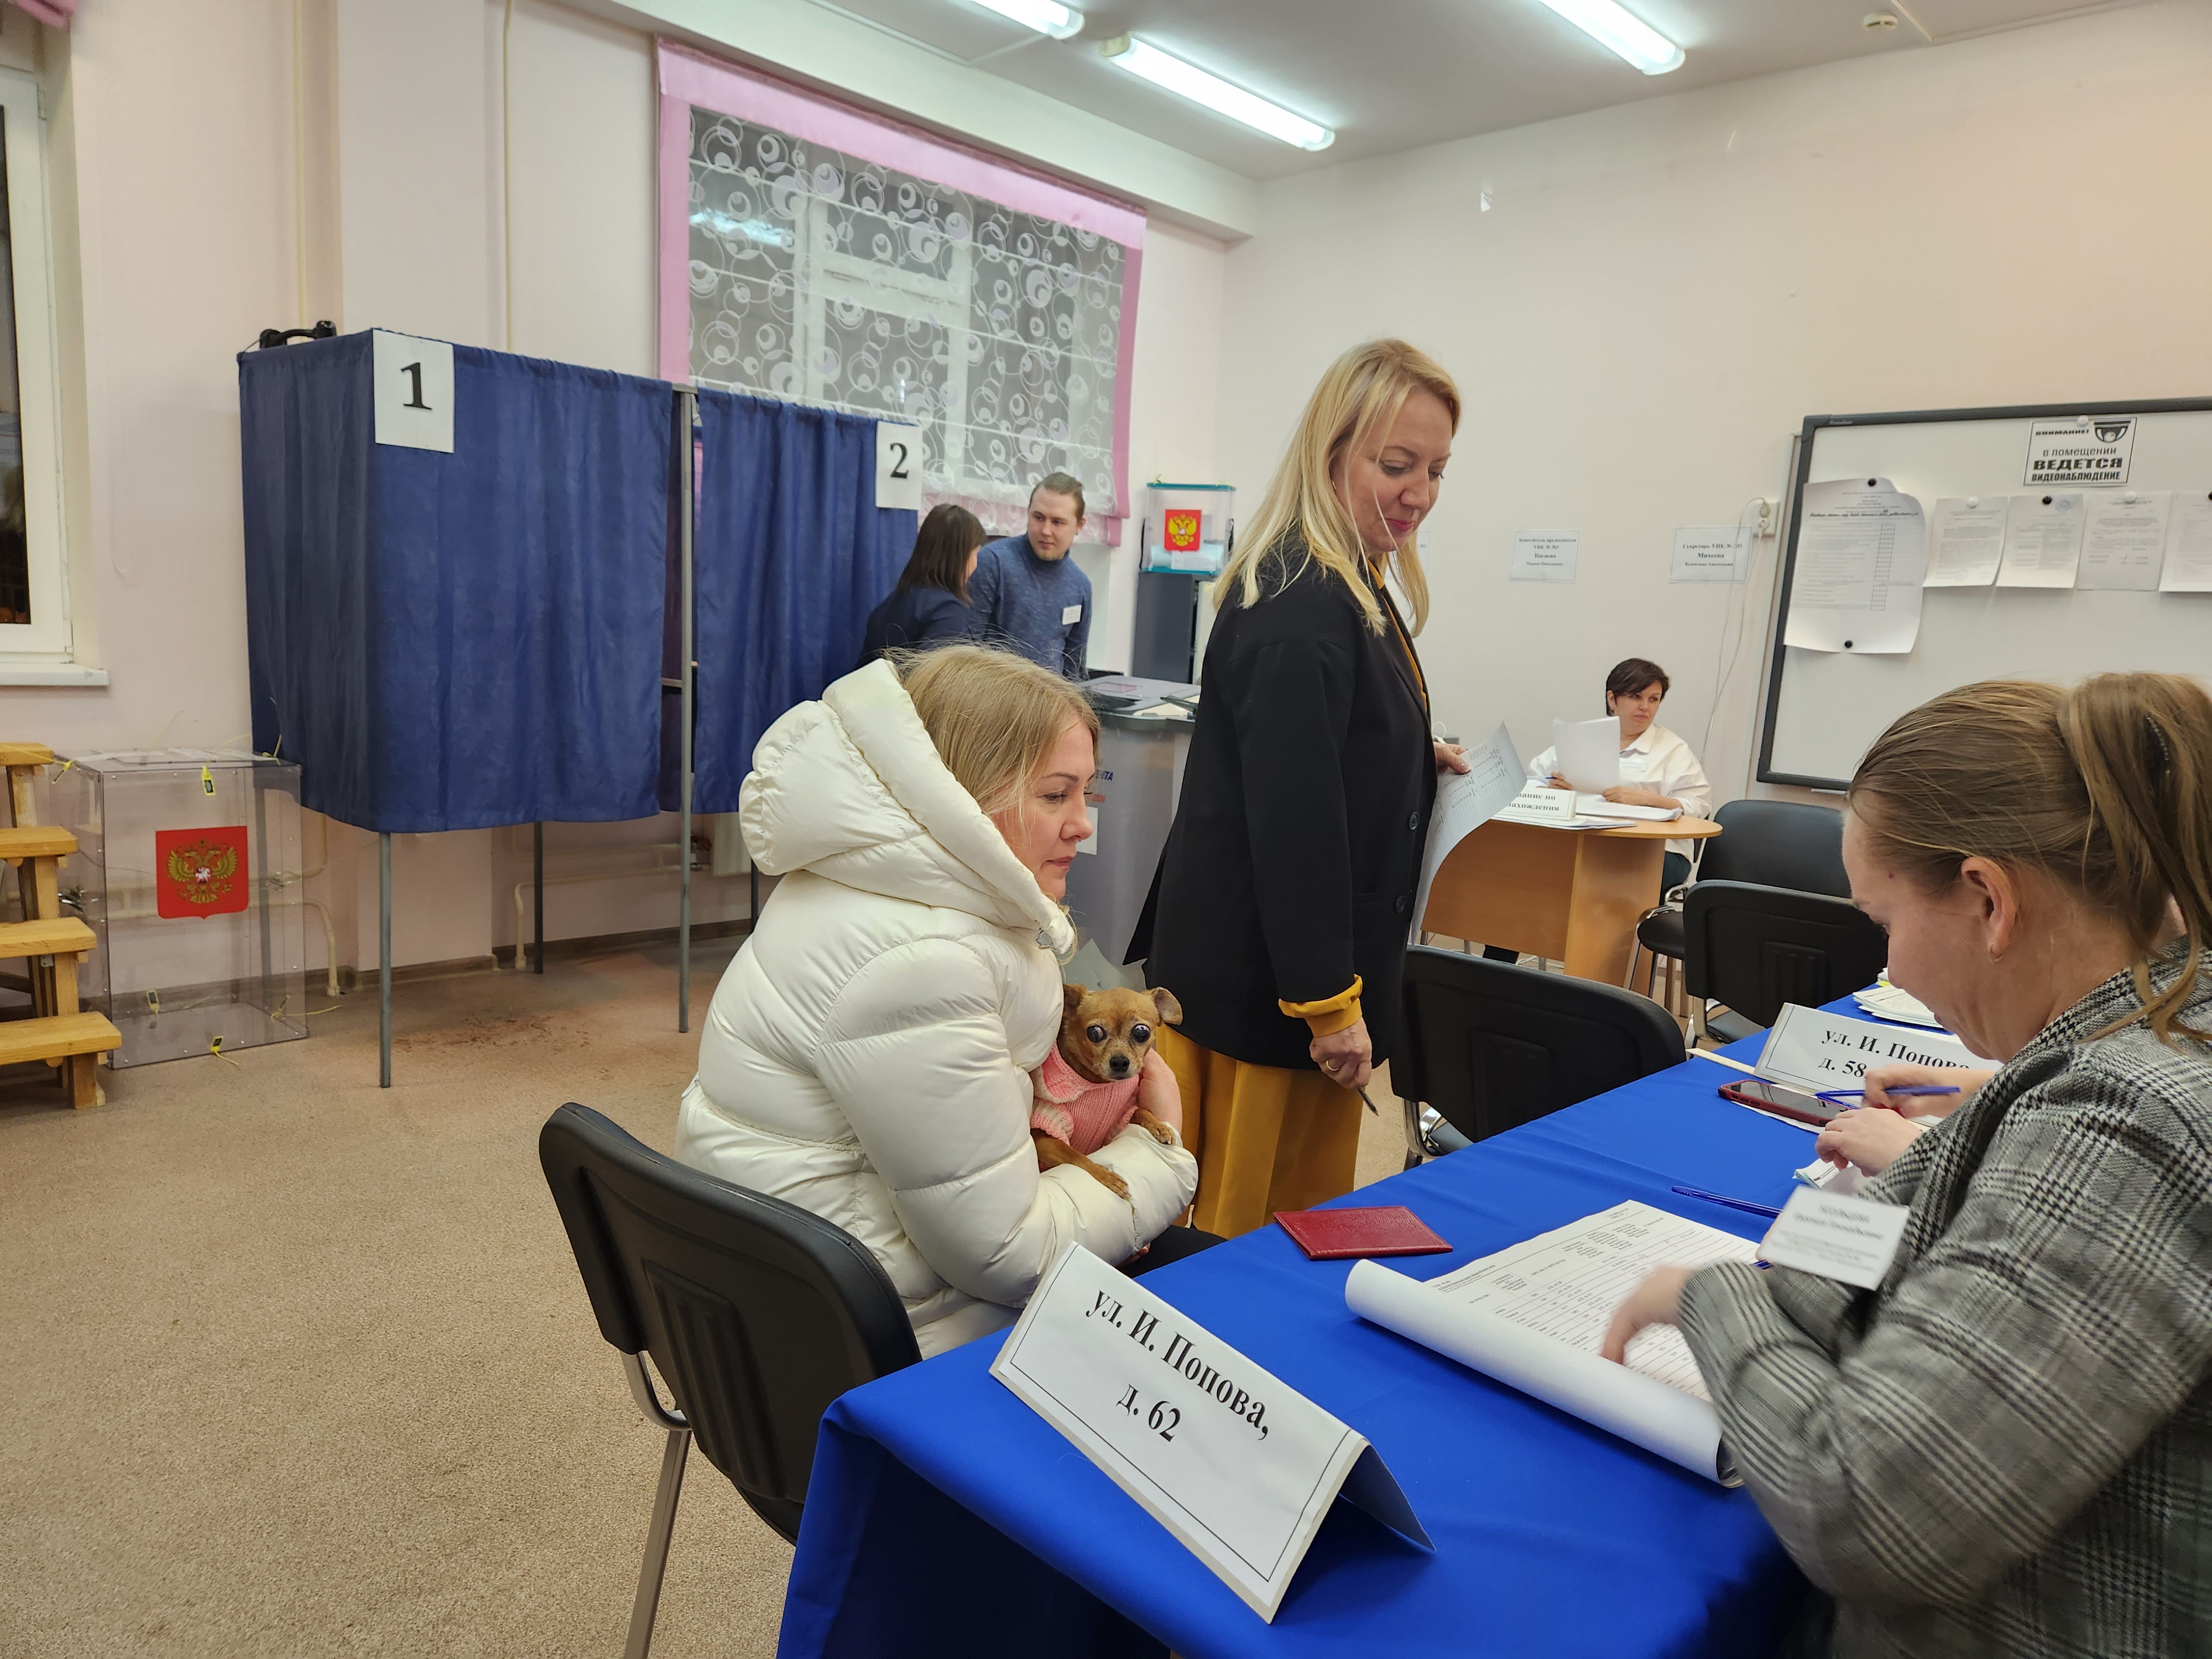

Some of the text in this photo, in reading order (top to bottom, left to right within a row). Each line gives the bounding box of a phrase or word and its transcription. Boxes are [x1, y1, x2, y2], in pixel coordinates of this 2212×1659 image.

[401, 362, 432, 410] 1
[890, 442, 909, 479] 2
[2033, 457, 2123, 471] ВЕДЕТСЯ
[2031, 471, 2121, 483] ВИДЕОНАБЛЮДЕНИЕ
[1821, 1030, 1851, 1046] ул.
[1858, 1035, 1880, 1054] И.
[1818, 1057, 1867, 1078] д. 58
[1086, 1290, 1269, 1441] ул. И. Попова,
[1115, 1384, 1181, 1443] д. 62
